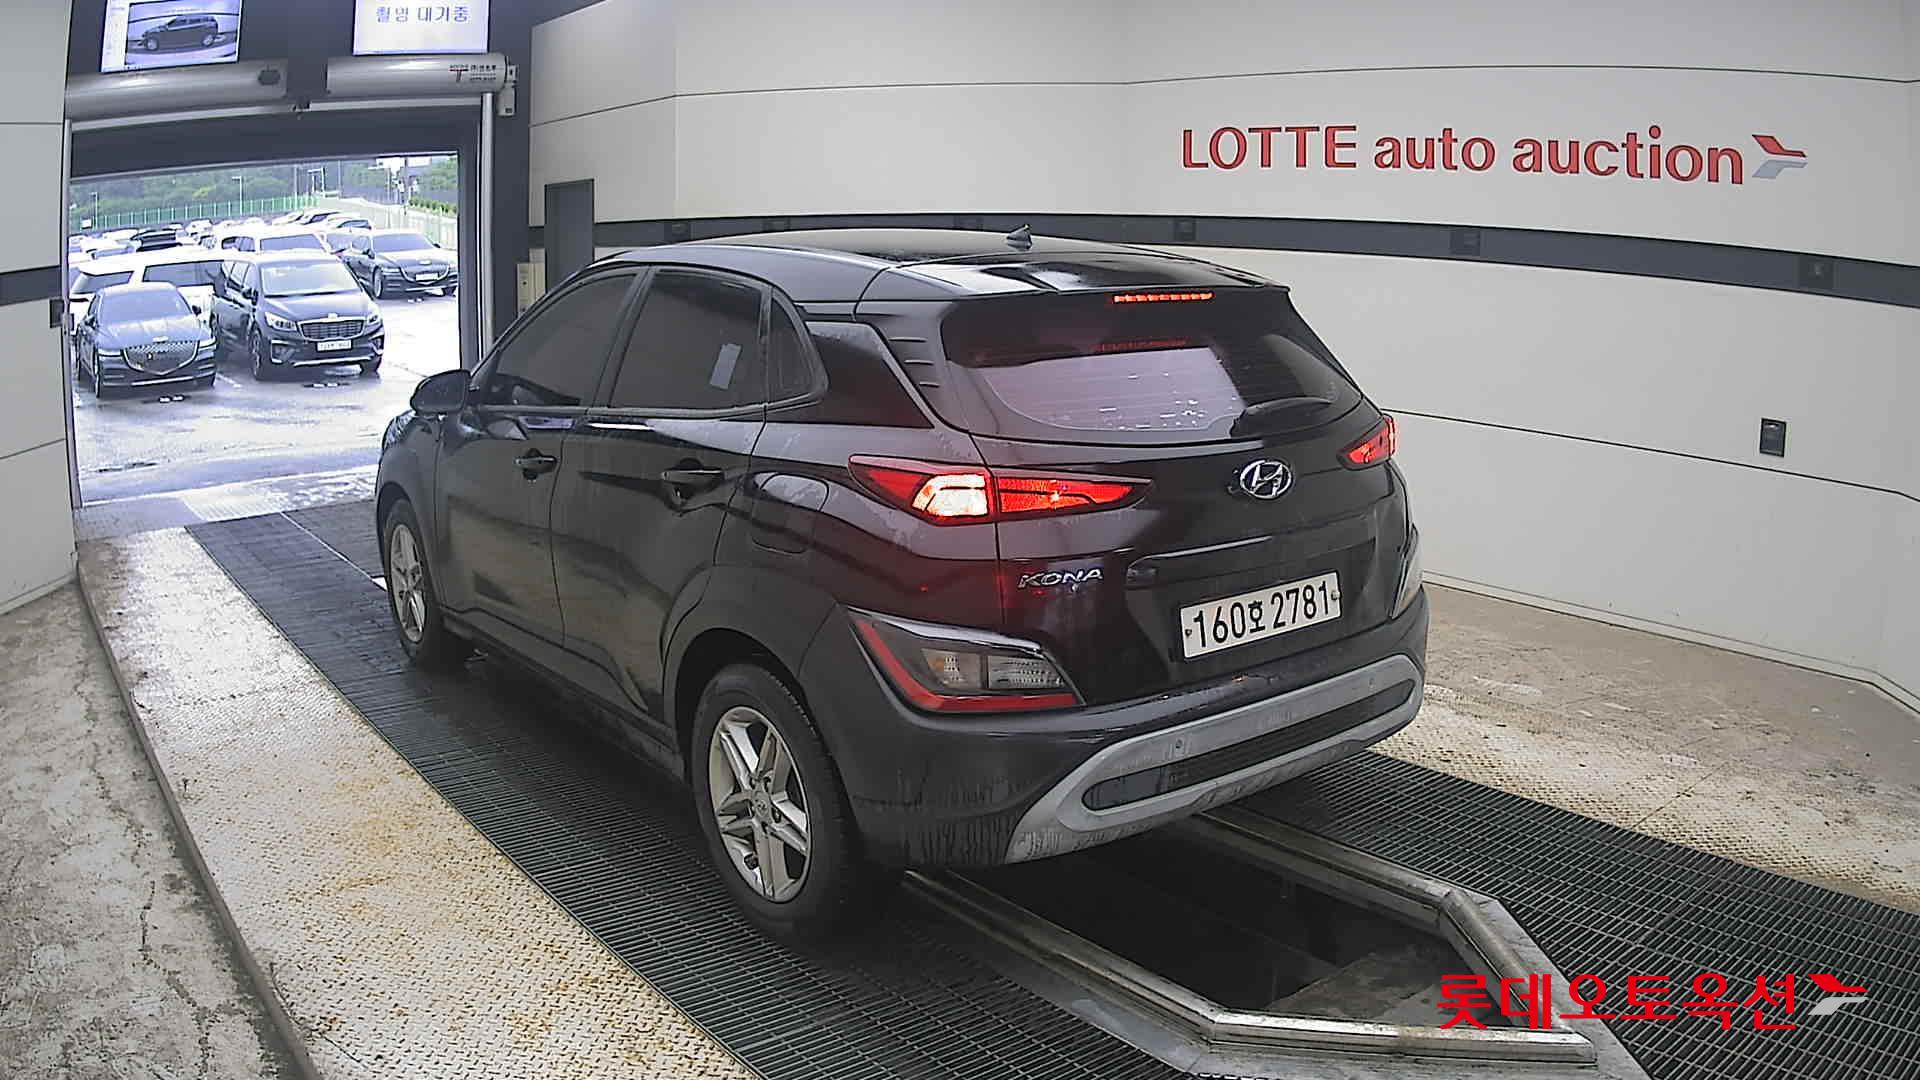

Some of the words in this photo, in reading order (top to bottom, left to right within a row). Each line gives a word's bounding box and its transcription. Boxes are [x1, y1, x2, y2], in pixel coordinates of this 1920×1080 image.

[417, 6, 468, 22] 대기중
[1182, 125, 1357, 170] LOTTE
[1374, 127, 1495, 172] auto
[1512, 125, 1743, 185] auction
[1018, 567, 1104, 589] KONA
[1194, 601, 1266, 648] 160호
[1271, 581, 1330, 630] 2781
